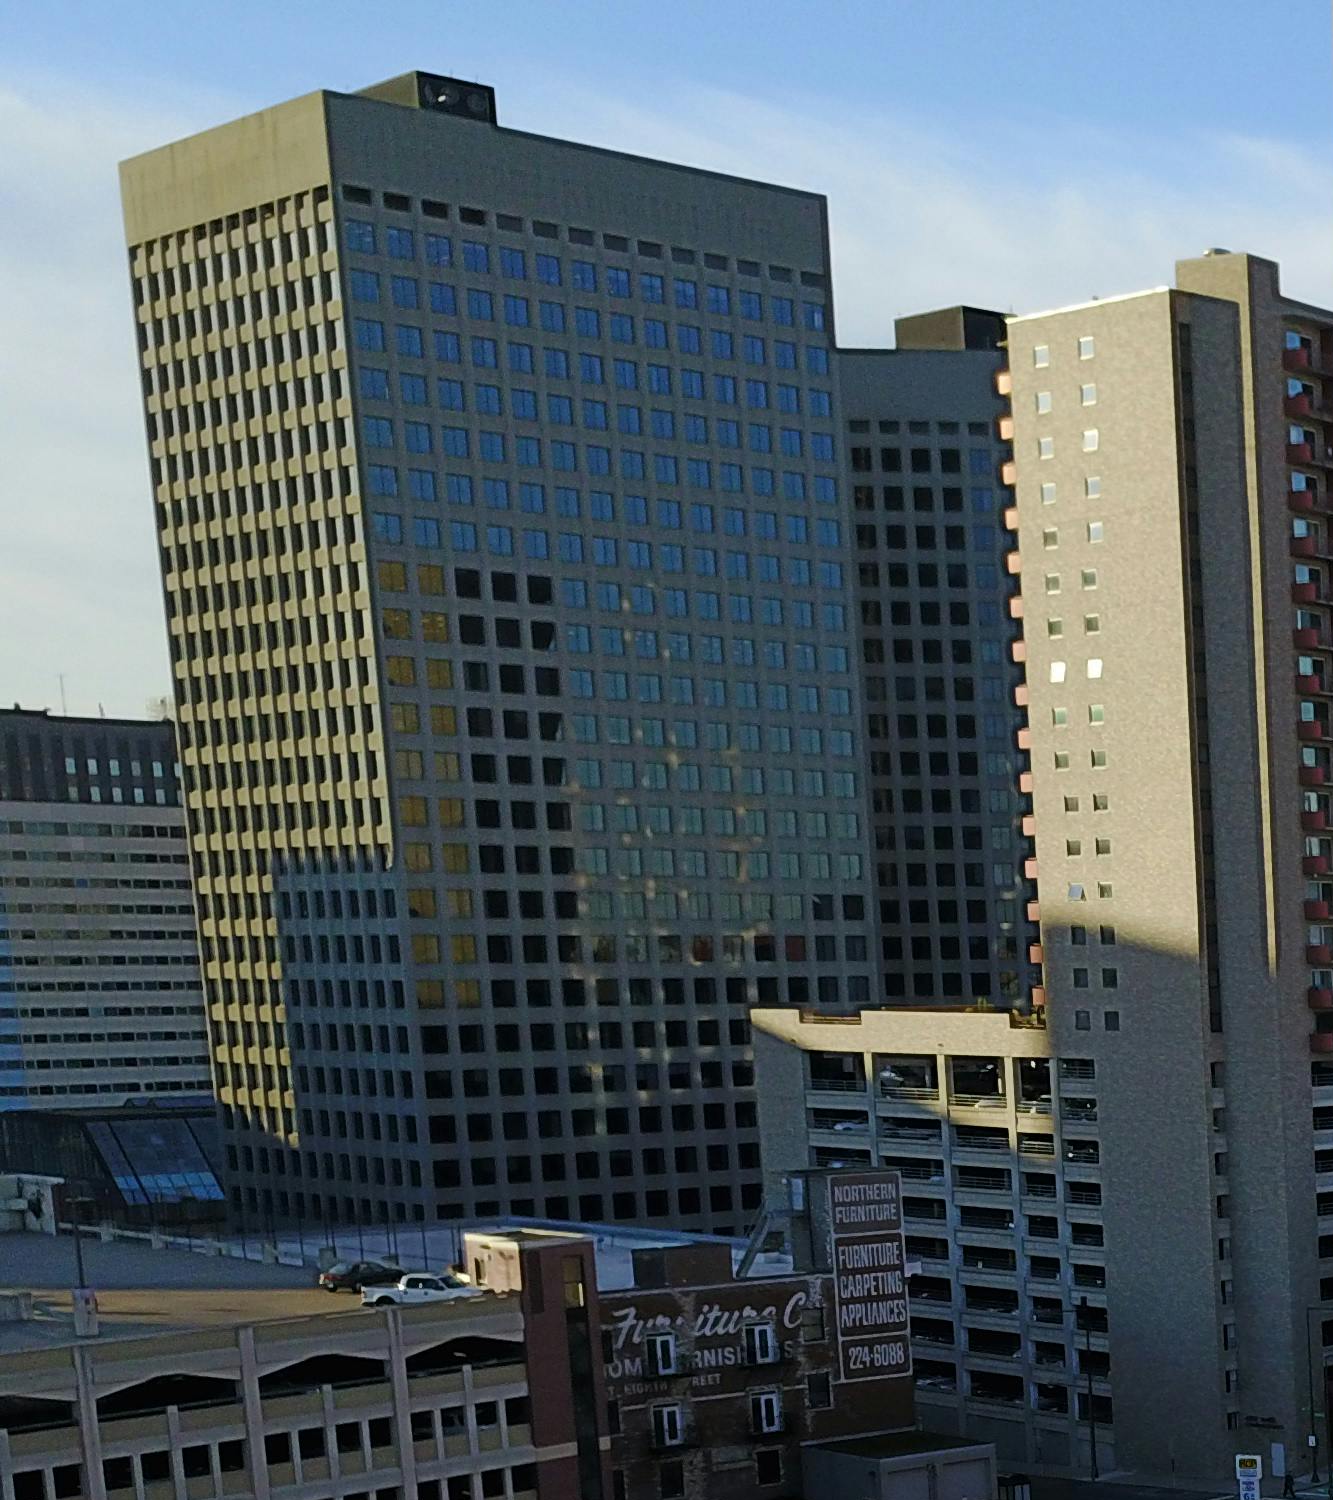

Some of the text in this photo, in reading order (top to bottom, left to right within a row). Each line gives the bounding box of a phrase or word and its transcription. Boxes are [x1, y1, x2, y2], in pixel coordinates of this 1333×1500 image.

[834, 1183, 896, 1203] NORTHERN
[835, 1203, 897, 1224] FURNITURE
[838, 1241, 900, 1269] FURNITURE
[840, 1270, 903, 1299] CARPETING
[841, 1299, 906, 1328] APPLIANCES
